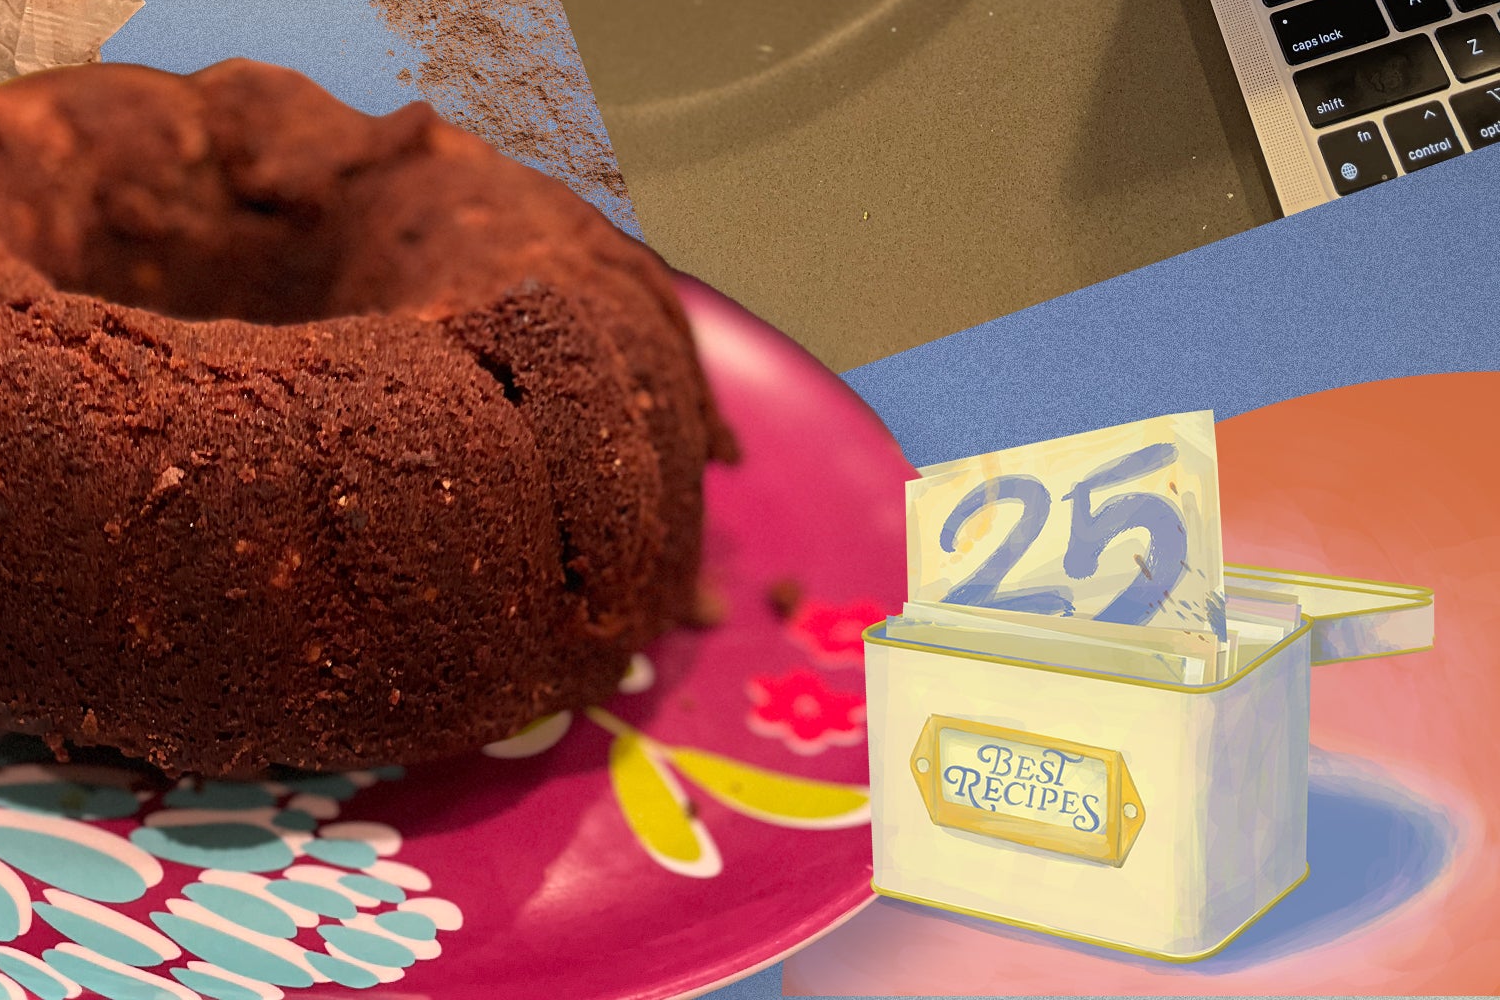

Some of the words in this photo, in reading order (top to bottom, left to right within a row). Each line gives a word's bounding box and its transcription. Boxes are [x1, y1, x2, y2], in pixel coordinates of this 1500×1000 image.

[1292, 37, 1319, 53] caps
[1318, 28, 1344, 45] lock
[1466, 37, 1484, 56] Z
[1316, 97, 1345, 115] shift
[1357, 130, 1373, 144] fn
[1407, 136, 1453, 162] control
[938, 441, 1190, 627] 25
[976, 743, 1085, 788] BEST
[942, 765, 1102, 834] RECIPES
